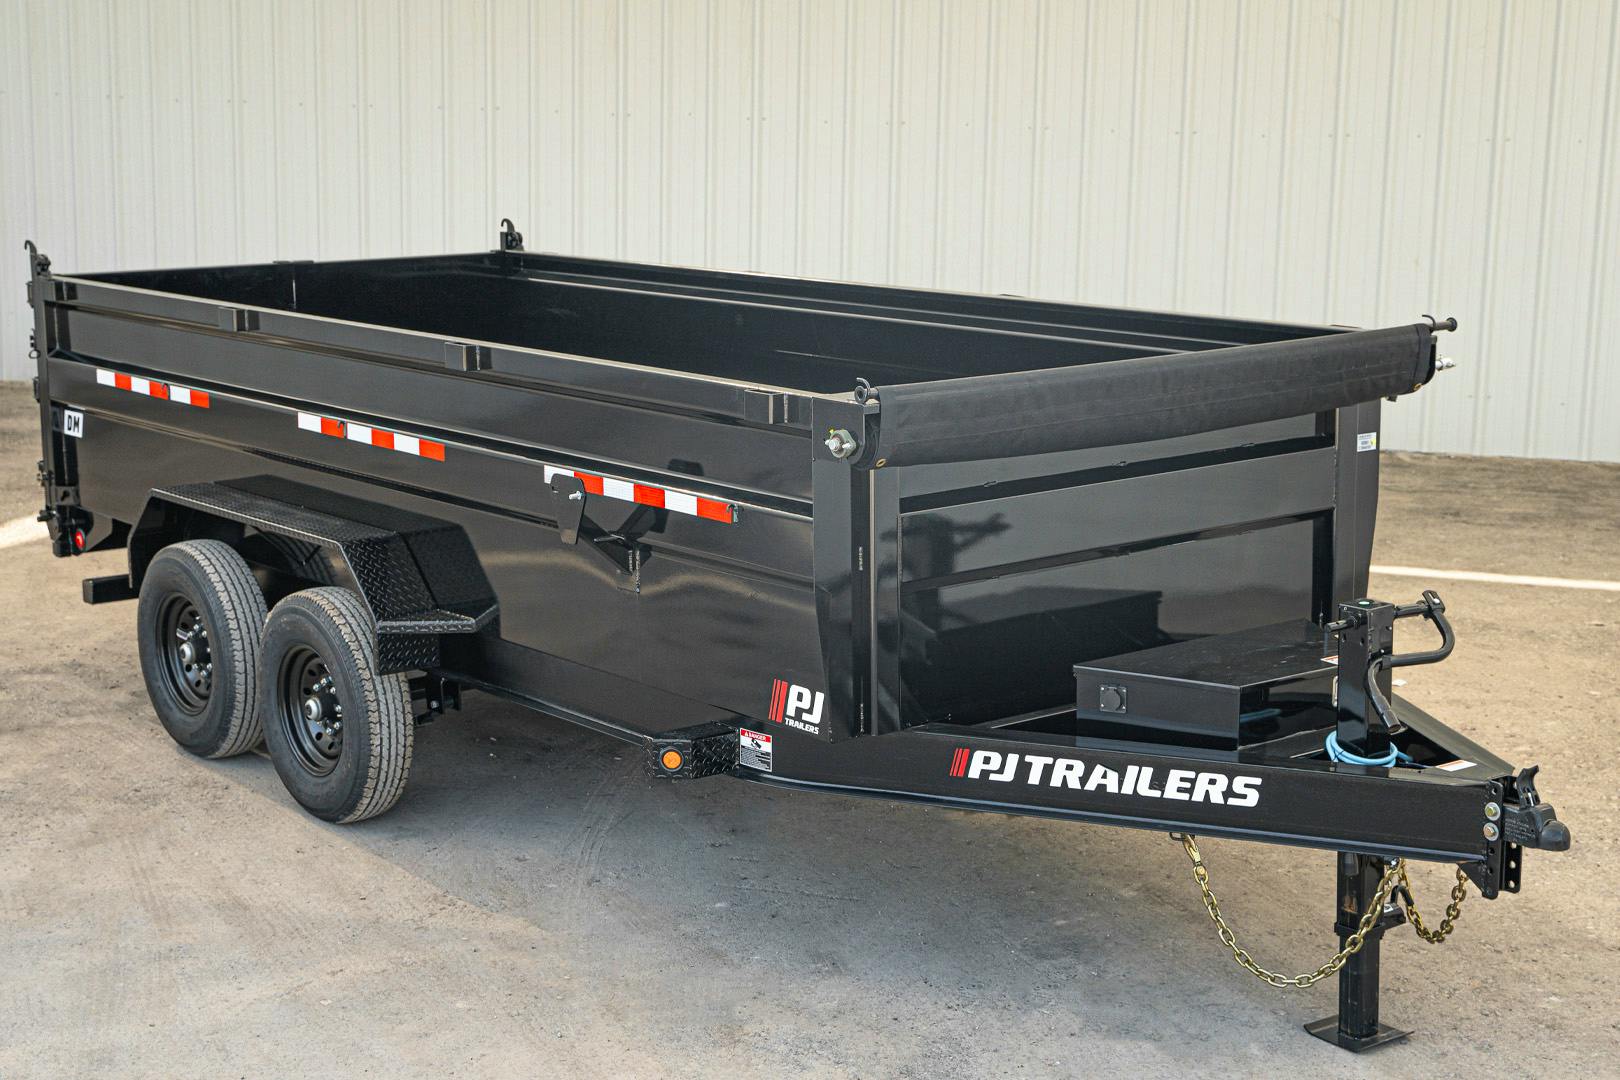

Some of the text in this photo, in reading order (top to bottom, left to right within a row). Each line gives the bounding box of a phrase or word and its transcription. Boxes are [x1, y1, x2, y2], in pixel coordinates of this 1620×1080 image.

[67, 414, 81, 433] DM
[786, 684, 825, 724] PJ
[784, 717, 820, 735] TRAILERS
[748, 730, 766, 742] DANGER
[967, 750, 1263, 807] PJ TRAILERS
